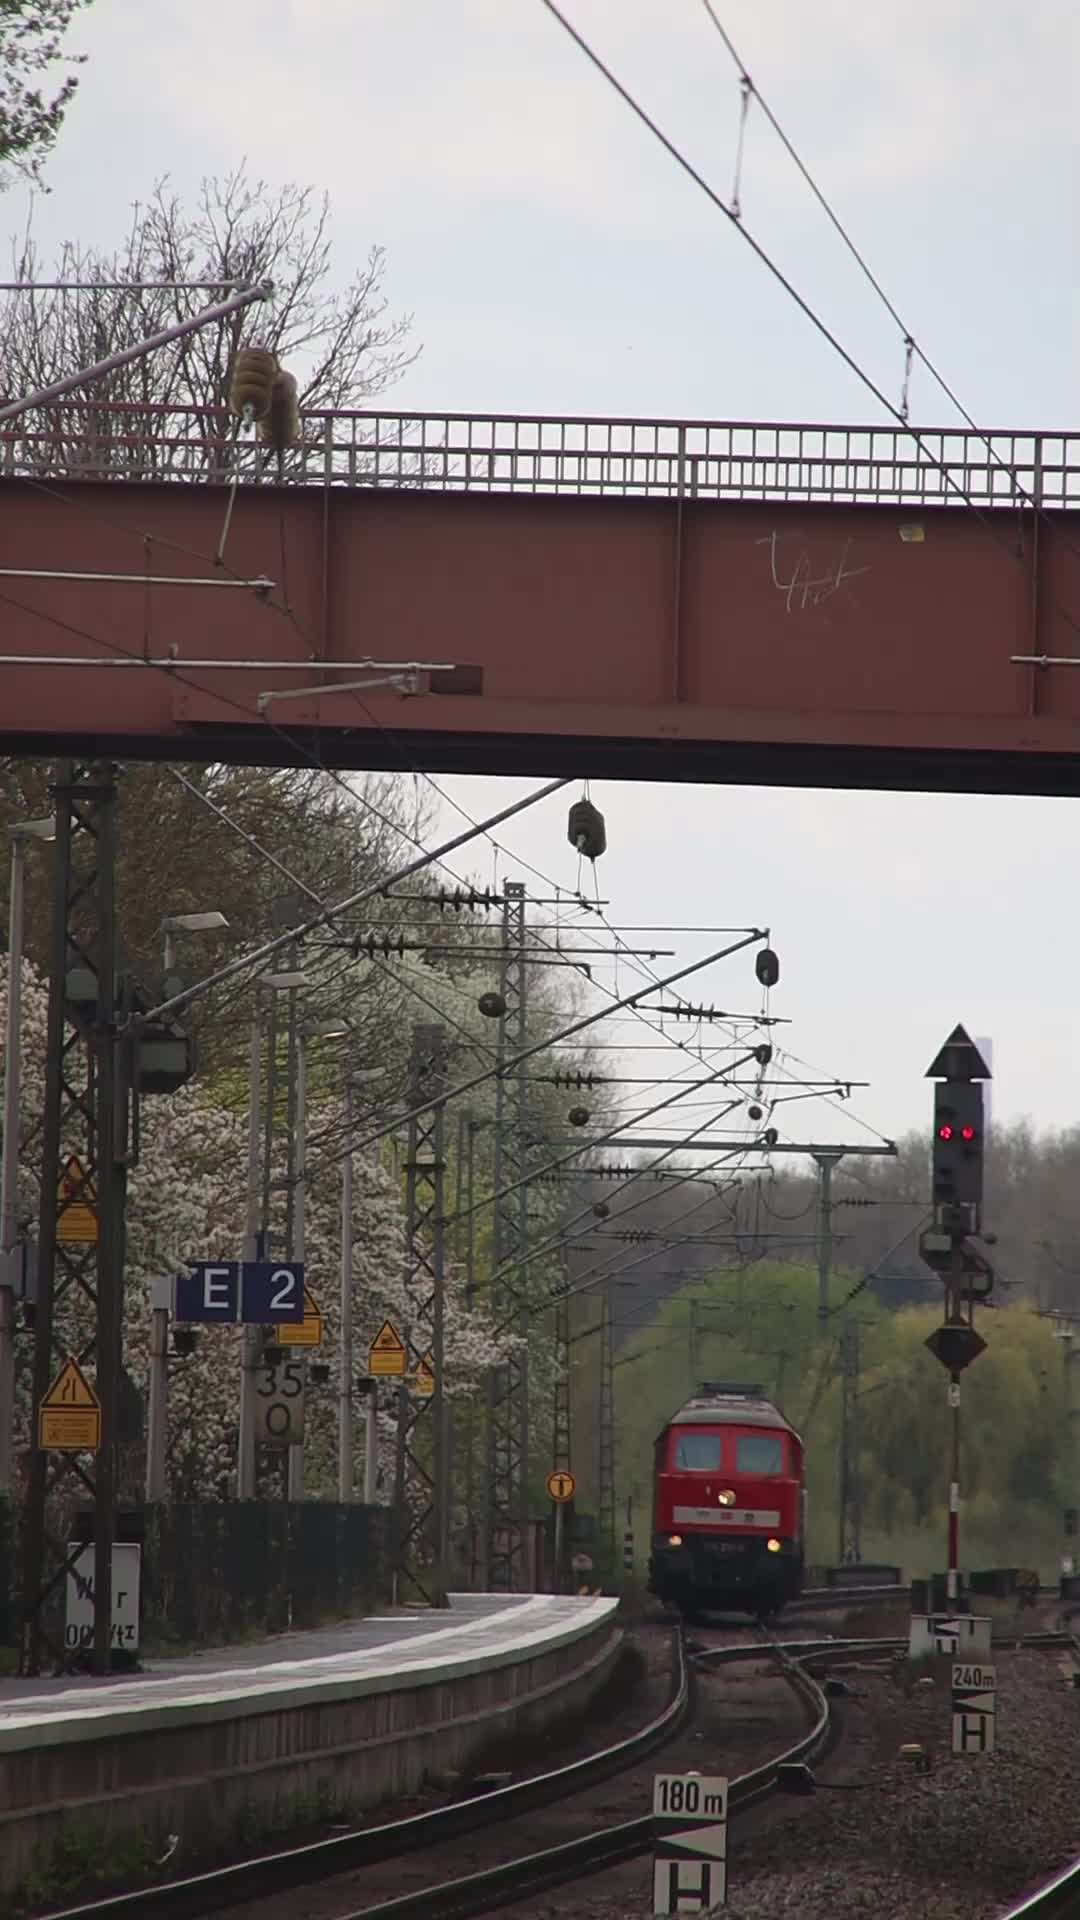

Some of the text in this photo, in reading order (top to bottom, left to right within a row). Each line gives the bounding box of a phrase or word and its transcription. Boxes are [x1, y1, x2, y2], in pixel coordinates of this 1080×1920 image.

[203, 1268, 296, 1309] E 2
[256, 1365, 301, 1397] 35
[961, 1715, 986, 1751] H
[658, 1780, 723, 1815] 180 m
[669, 1862, 712, 1914] H
